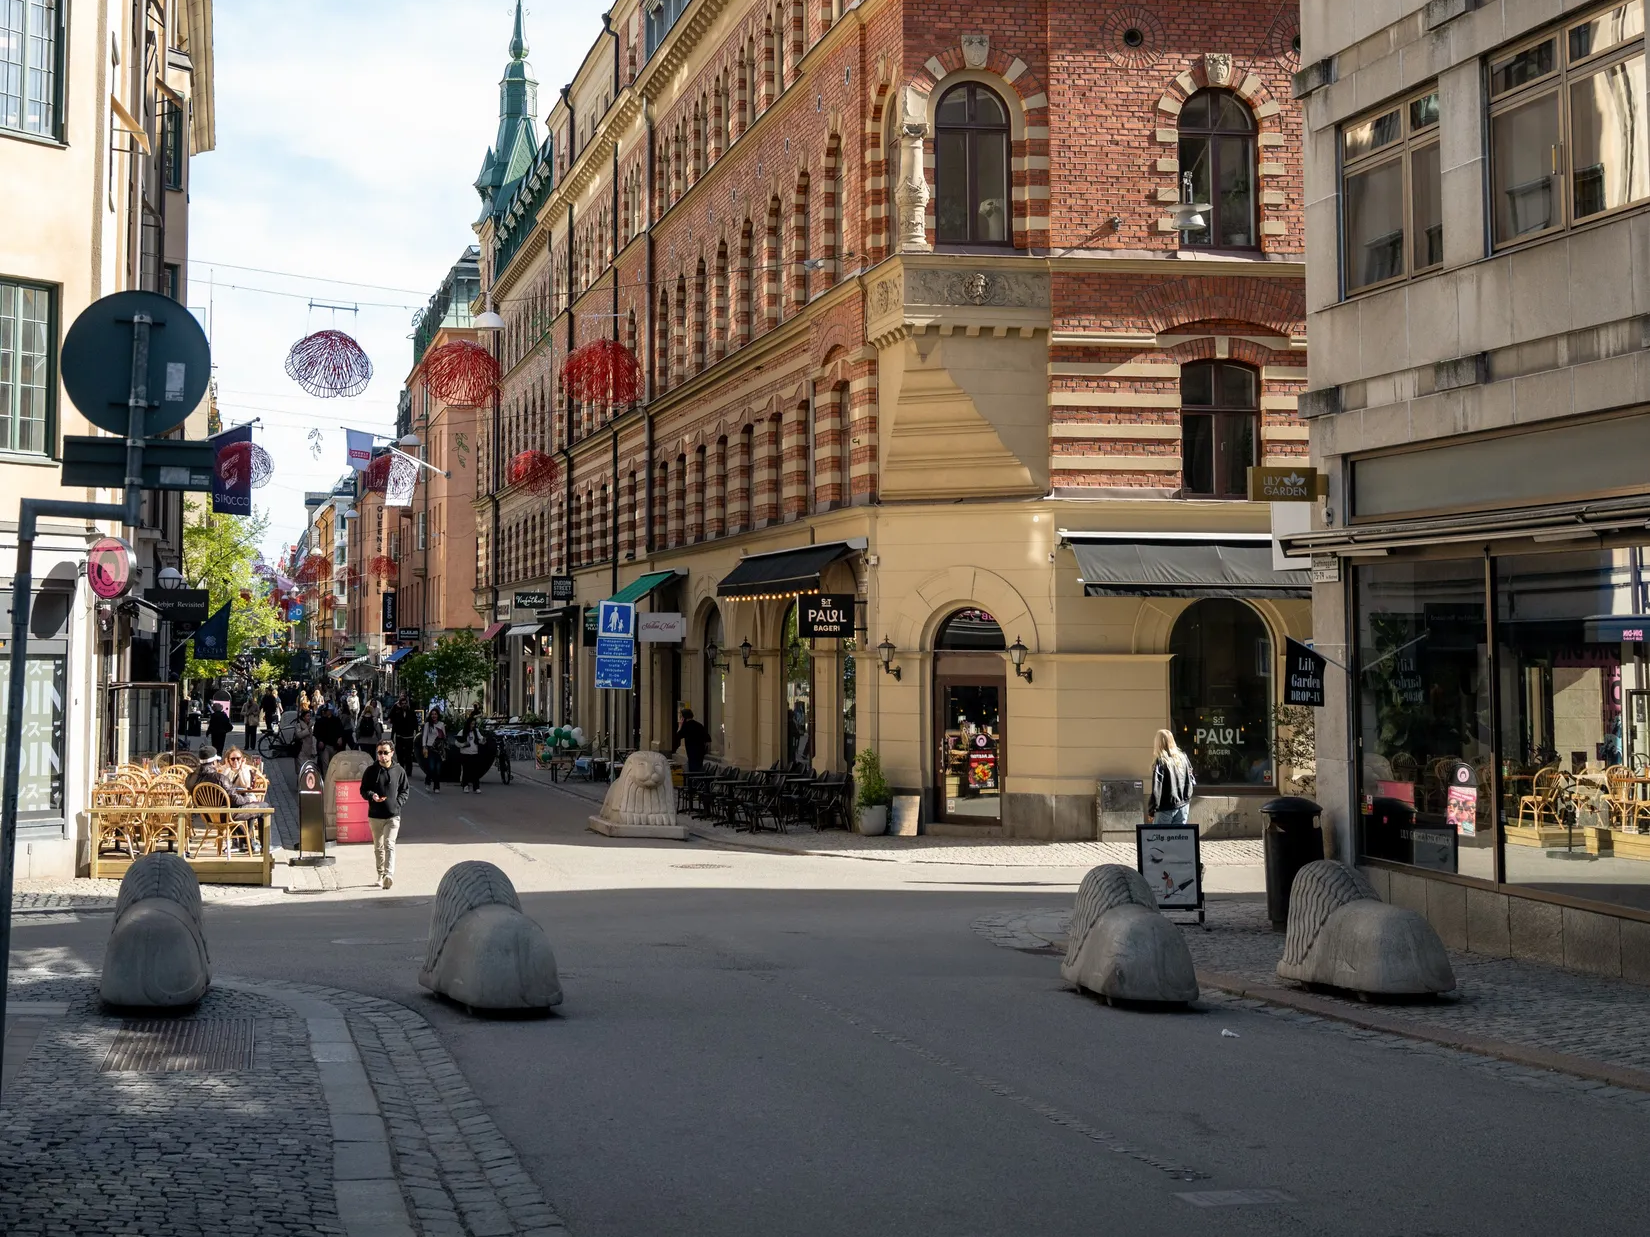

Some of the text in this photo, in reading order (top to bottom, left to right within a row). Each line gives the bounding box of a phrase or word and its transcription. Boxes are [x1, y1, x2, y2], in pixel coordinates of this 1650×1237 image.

[1263, 475, 1281, 486] LILY
[1263, 486, 1307, 496] GARDEN
[808, 609, 847, 622] PAUL
[1298, 657, 1315, 673] Lily
[1291, 673, 1321, 689] Garden
[1196, 728, 1245, 745] PAUL
[1147, 834, 1189, 842] Lily garden
